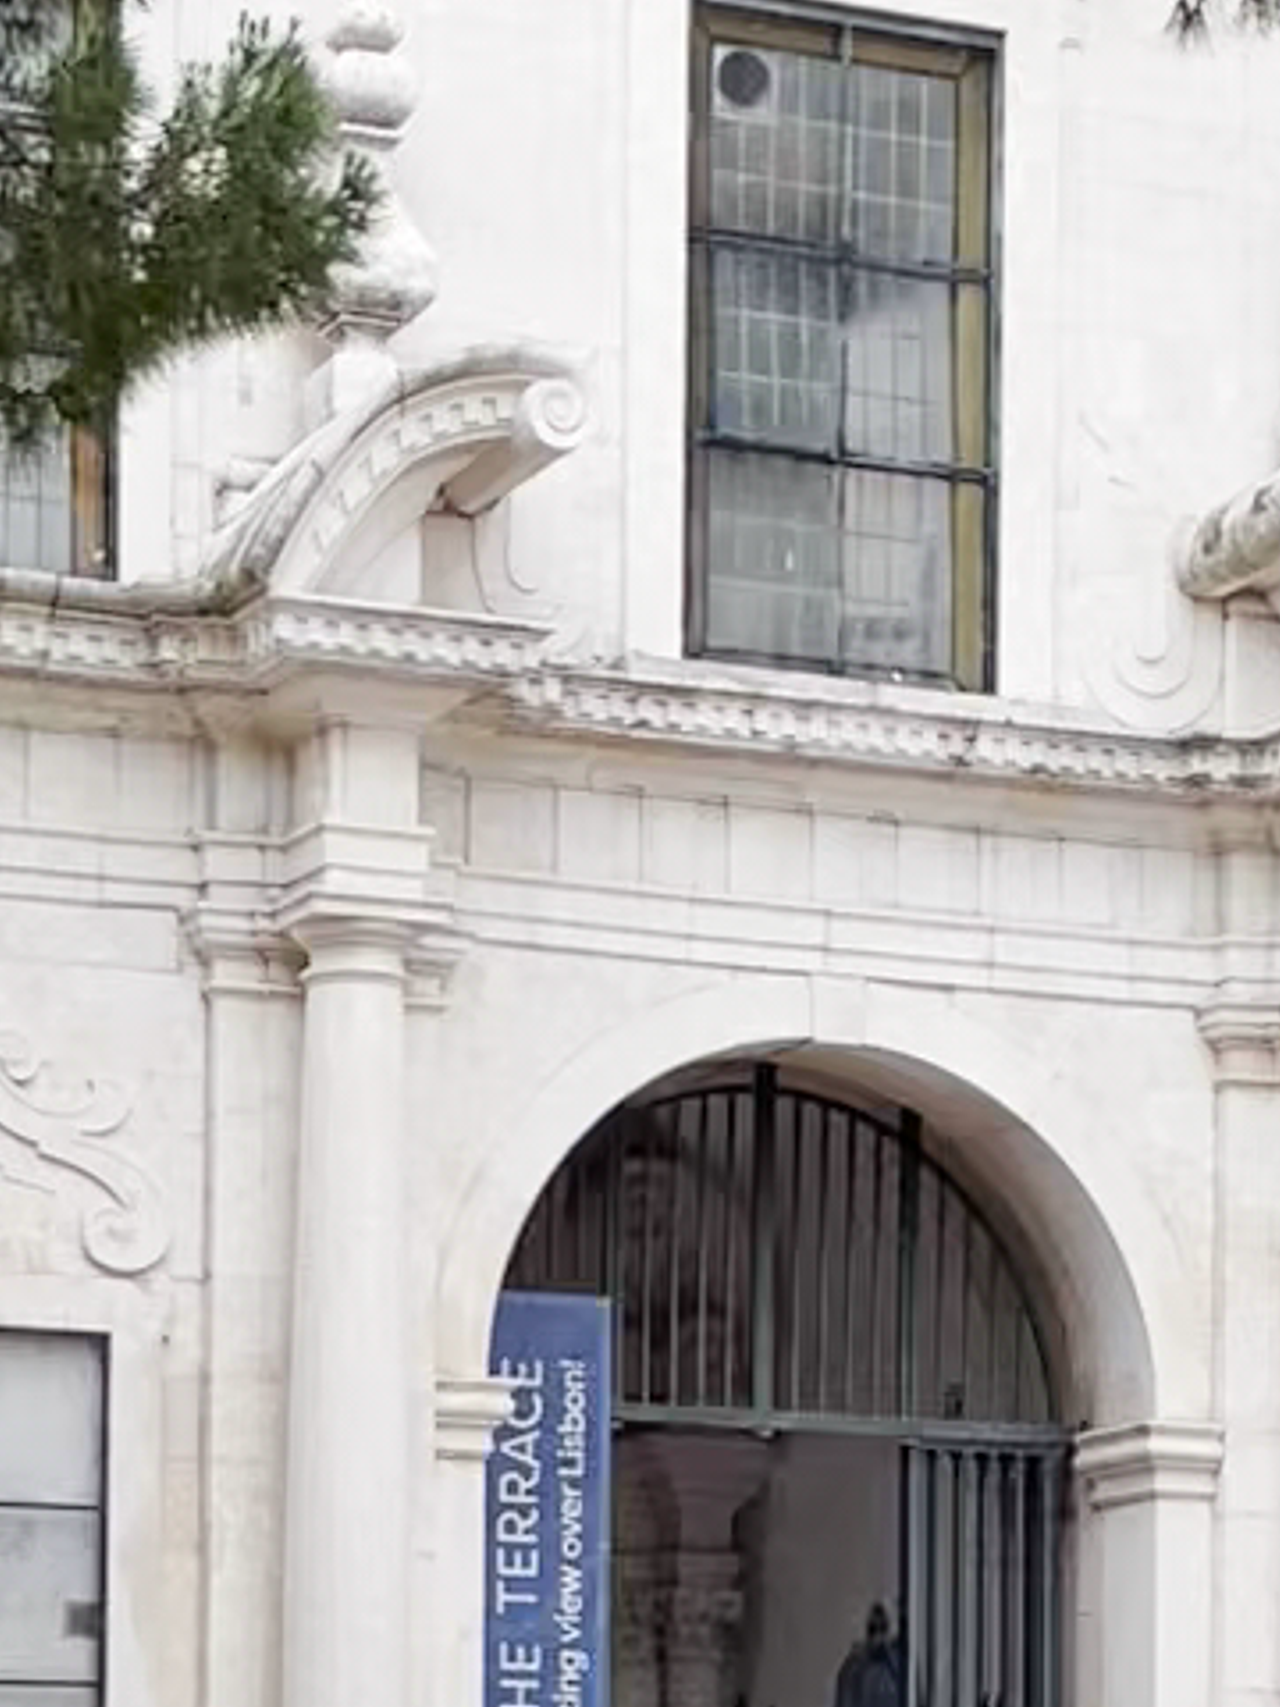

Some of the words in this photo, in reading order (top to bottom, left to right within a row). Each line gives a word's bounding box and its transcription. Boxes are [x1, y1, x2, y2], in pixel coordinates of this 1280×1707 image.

[557, 1359, 587, 1476] Lisbon!
[496, 1356, 544, 1615] TERRACE
[560, 1479, 584, 1560] over
[553, 1565, 583, 1644] view
